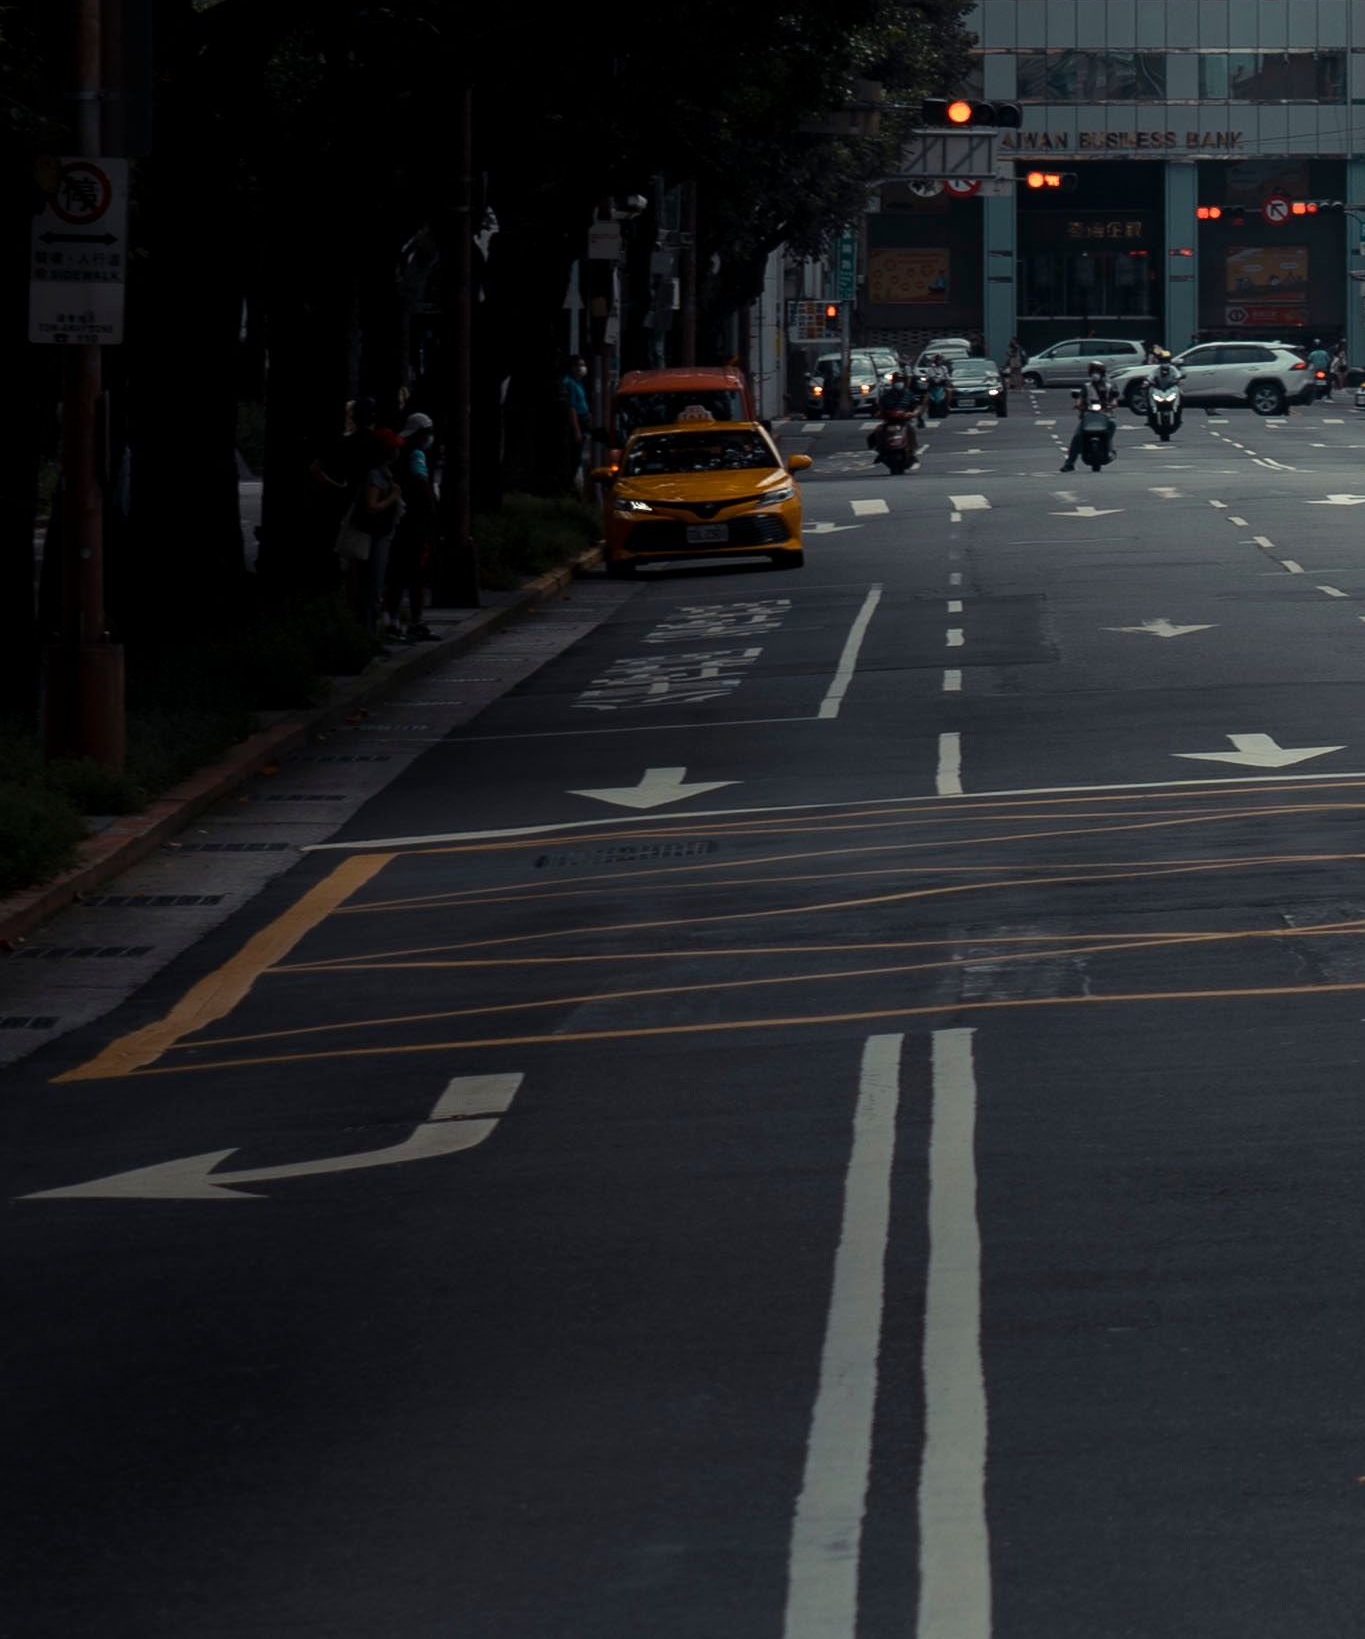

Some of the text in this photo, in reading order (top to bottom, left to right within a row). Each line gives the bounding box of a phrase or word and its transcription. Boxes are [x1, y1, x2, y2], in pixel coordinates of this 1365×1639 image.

[1002, 131, 1244, 149] AIWAN BUSINESS BANK
